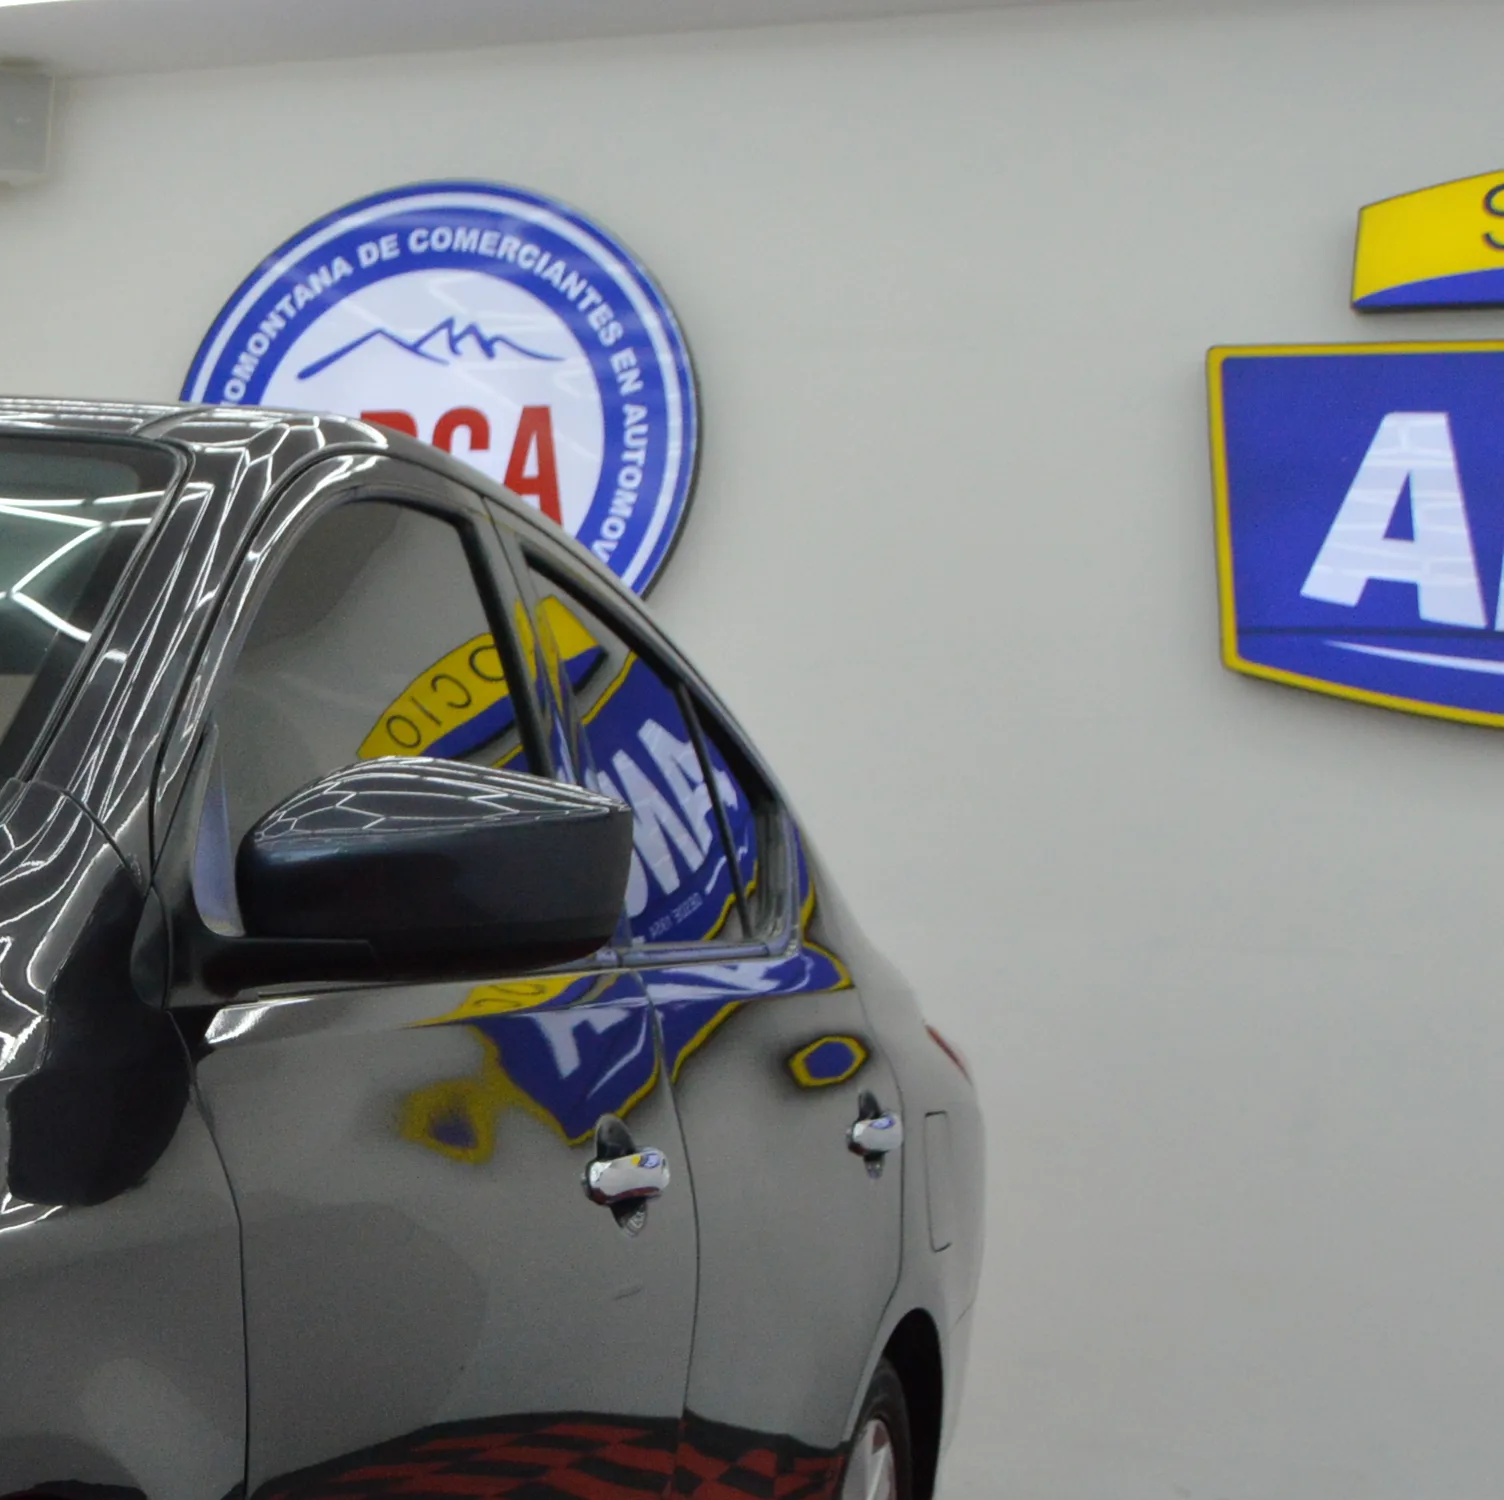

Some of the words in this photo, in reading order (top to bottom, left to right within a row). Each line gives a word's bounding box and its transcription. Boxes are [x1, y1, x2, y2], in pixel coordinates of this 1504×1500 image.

[356, 234, 401, 268] DE
[408, 226, 623, 347] COMERCIANTES
[221, 256, 353, 406] OMONTANA
[609, 348, 643, 396] EN
[360, 405, 563, 527] CA
[592, 404, 648, 564] AUTOMOV
[1299, 412, 1504, 632] A
